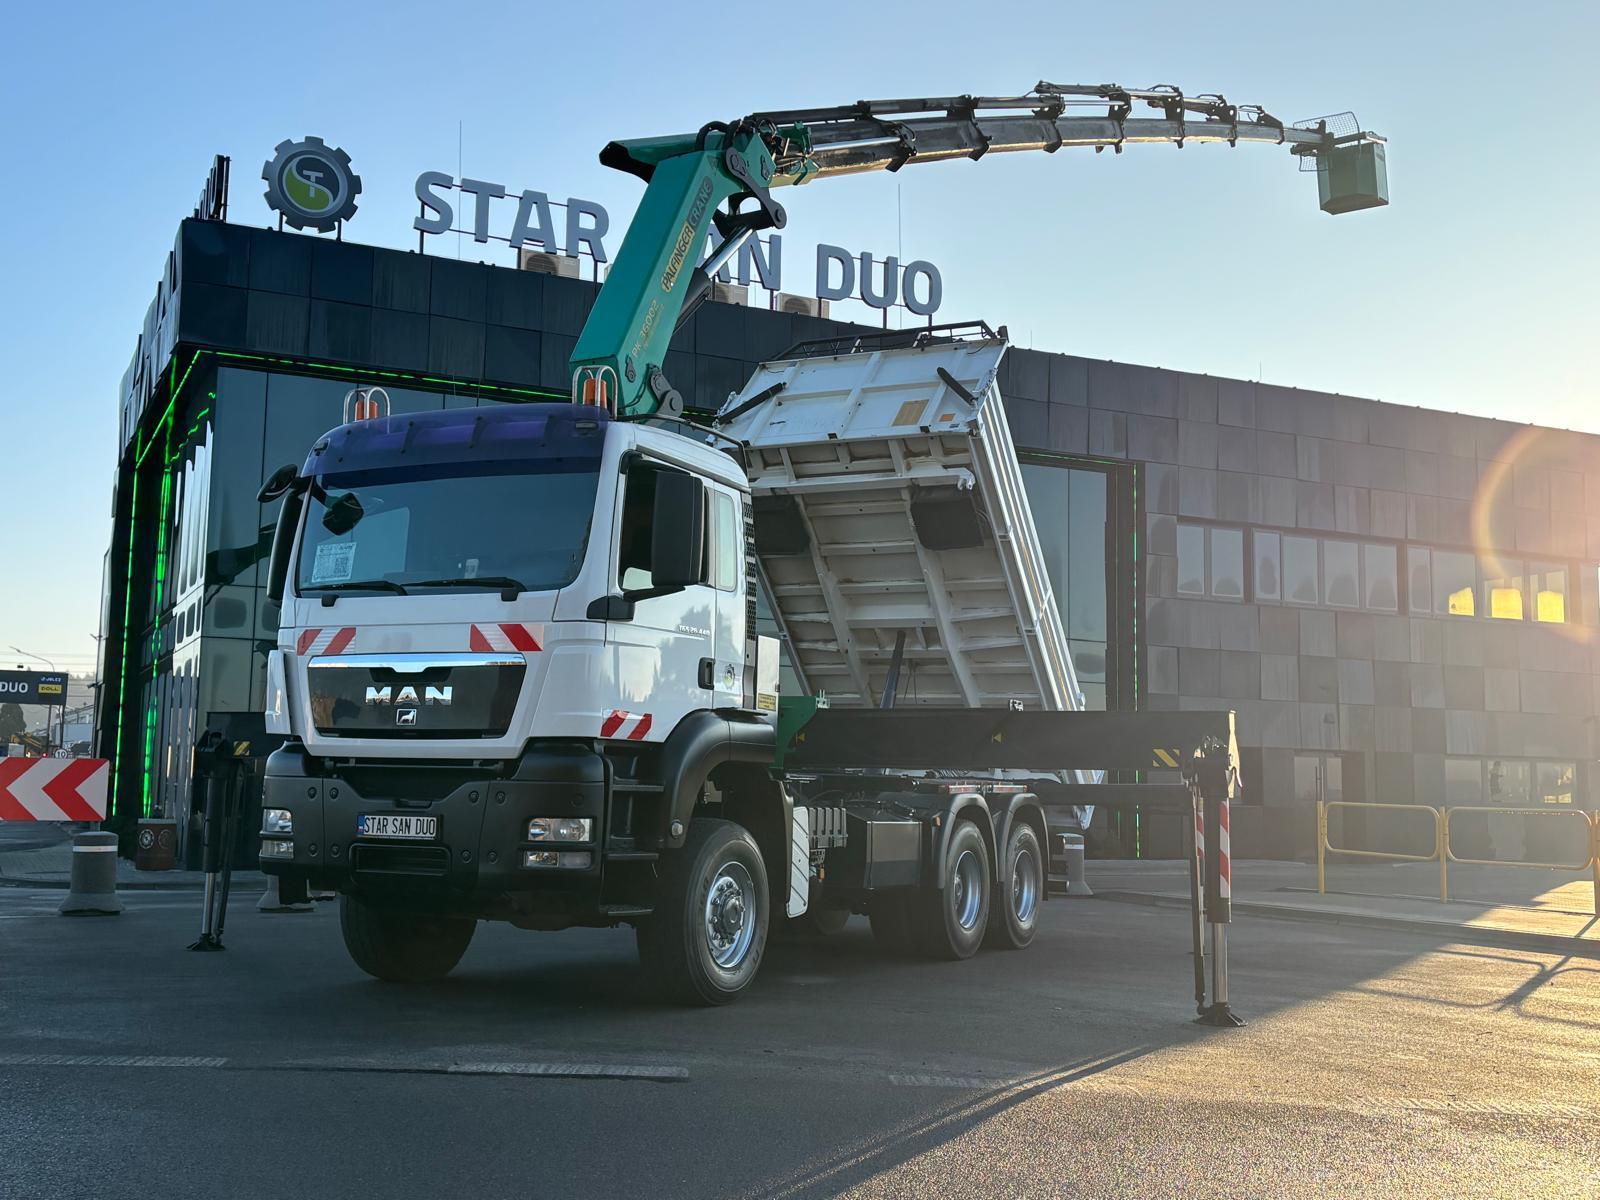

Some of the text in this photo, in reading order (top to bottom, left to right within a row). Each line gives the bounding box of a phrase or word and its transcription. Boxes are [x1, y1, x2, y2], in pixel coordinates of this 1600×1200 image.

[413, 171, 943, 315] STAR AN DUO
[662, 178, 713, 291] PALFINGER CRANE
[640, 299, 658, 337] 36002
[0, 682, 28, 693] DUO
[365, 686, 453, 706] MAN
[364, 817, 436, 836] STAR SAN DUO
